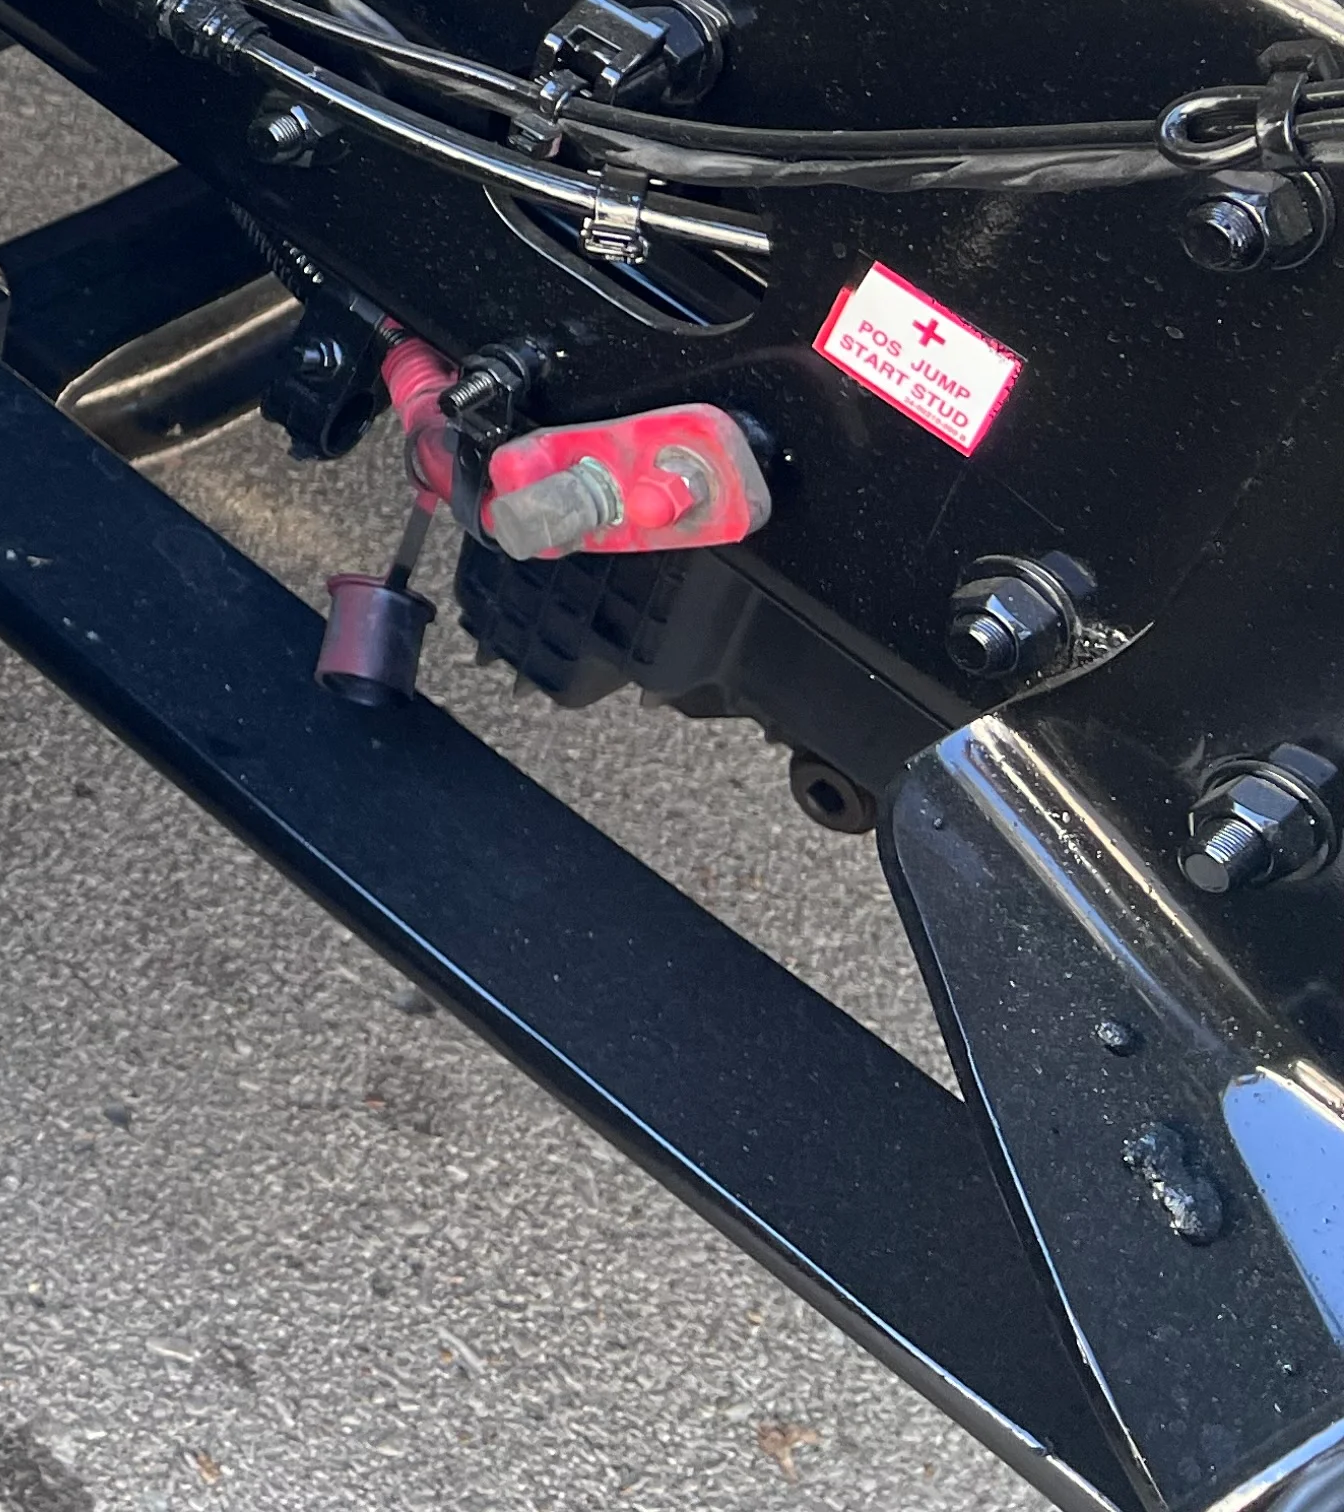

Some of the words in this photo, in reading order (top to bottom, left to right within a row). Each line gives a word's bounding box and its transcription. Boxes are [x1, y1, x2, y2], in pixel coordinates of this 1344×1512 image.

[839, 334, 910, 387] START
[910, 383, 969, 428] STUD
[858, 320, 902, 357] POS
[910, 359, 971, 400] JUMP
